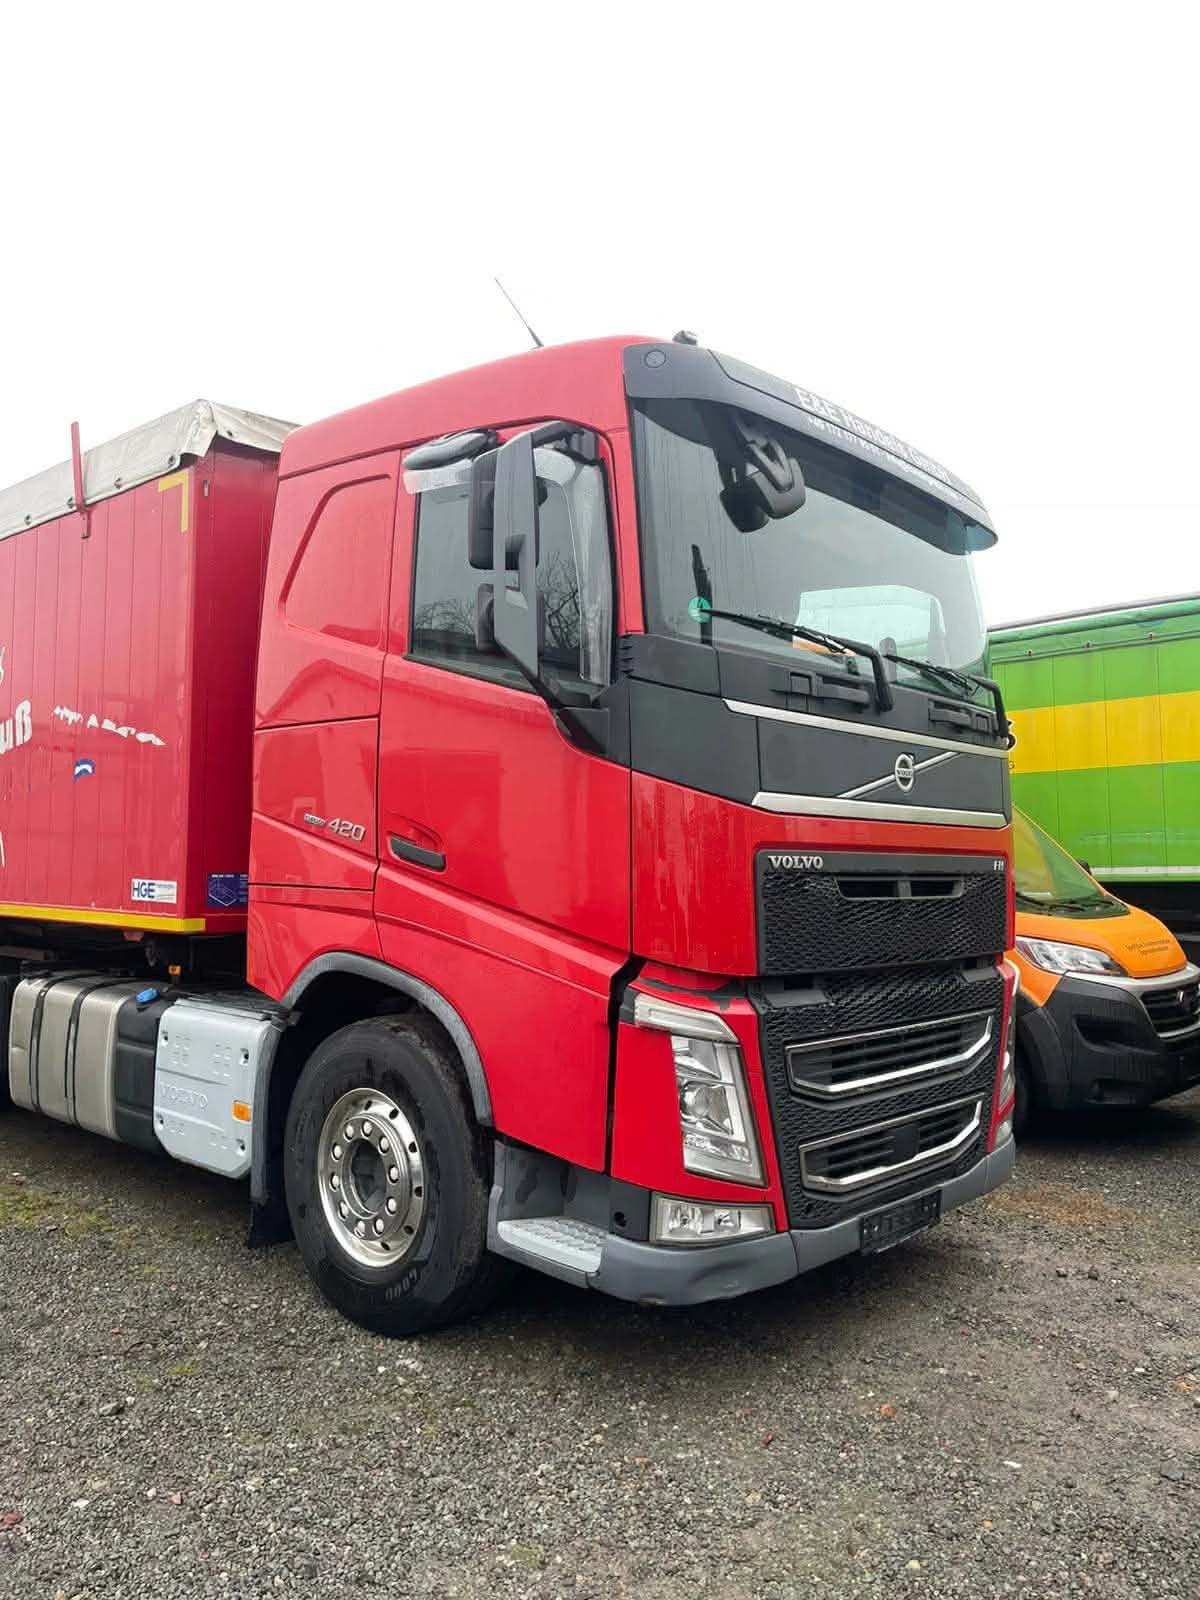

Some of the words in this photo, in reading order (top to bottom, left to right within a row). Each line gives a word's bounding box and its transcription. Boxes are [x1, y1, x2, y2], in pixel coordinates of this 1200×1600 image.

[328, 817, 366, 841] 420
[767, 855, 823, 869] VOLVO
[132, 881, 156, 899] HGE
